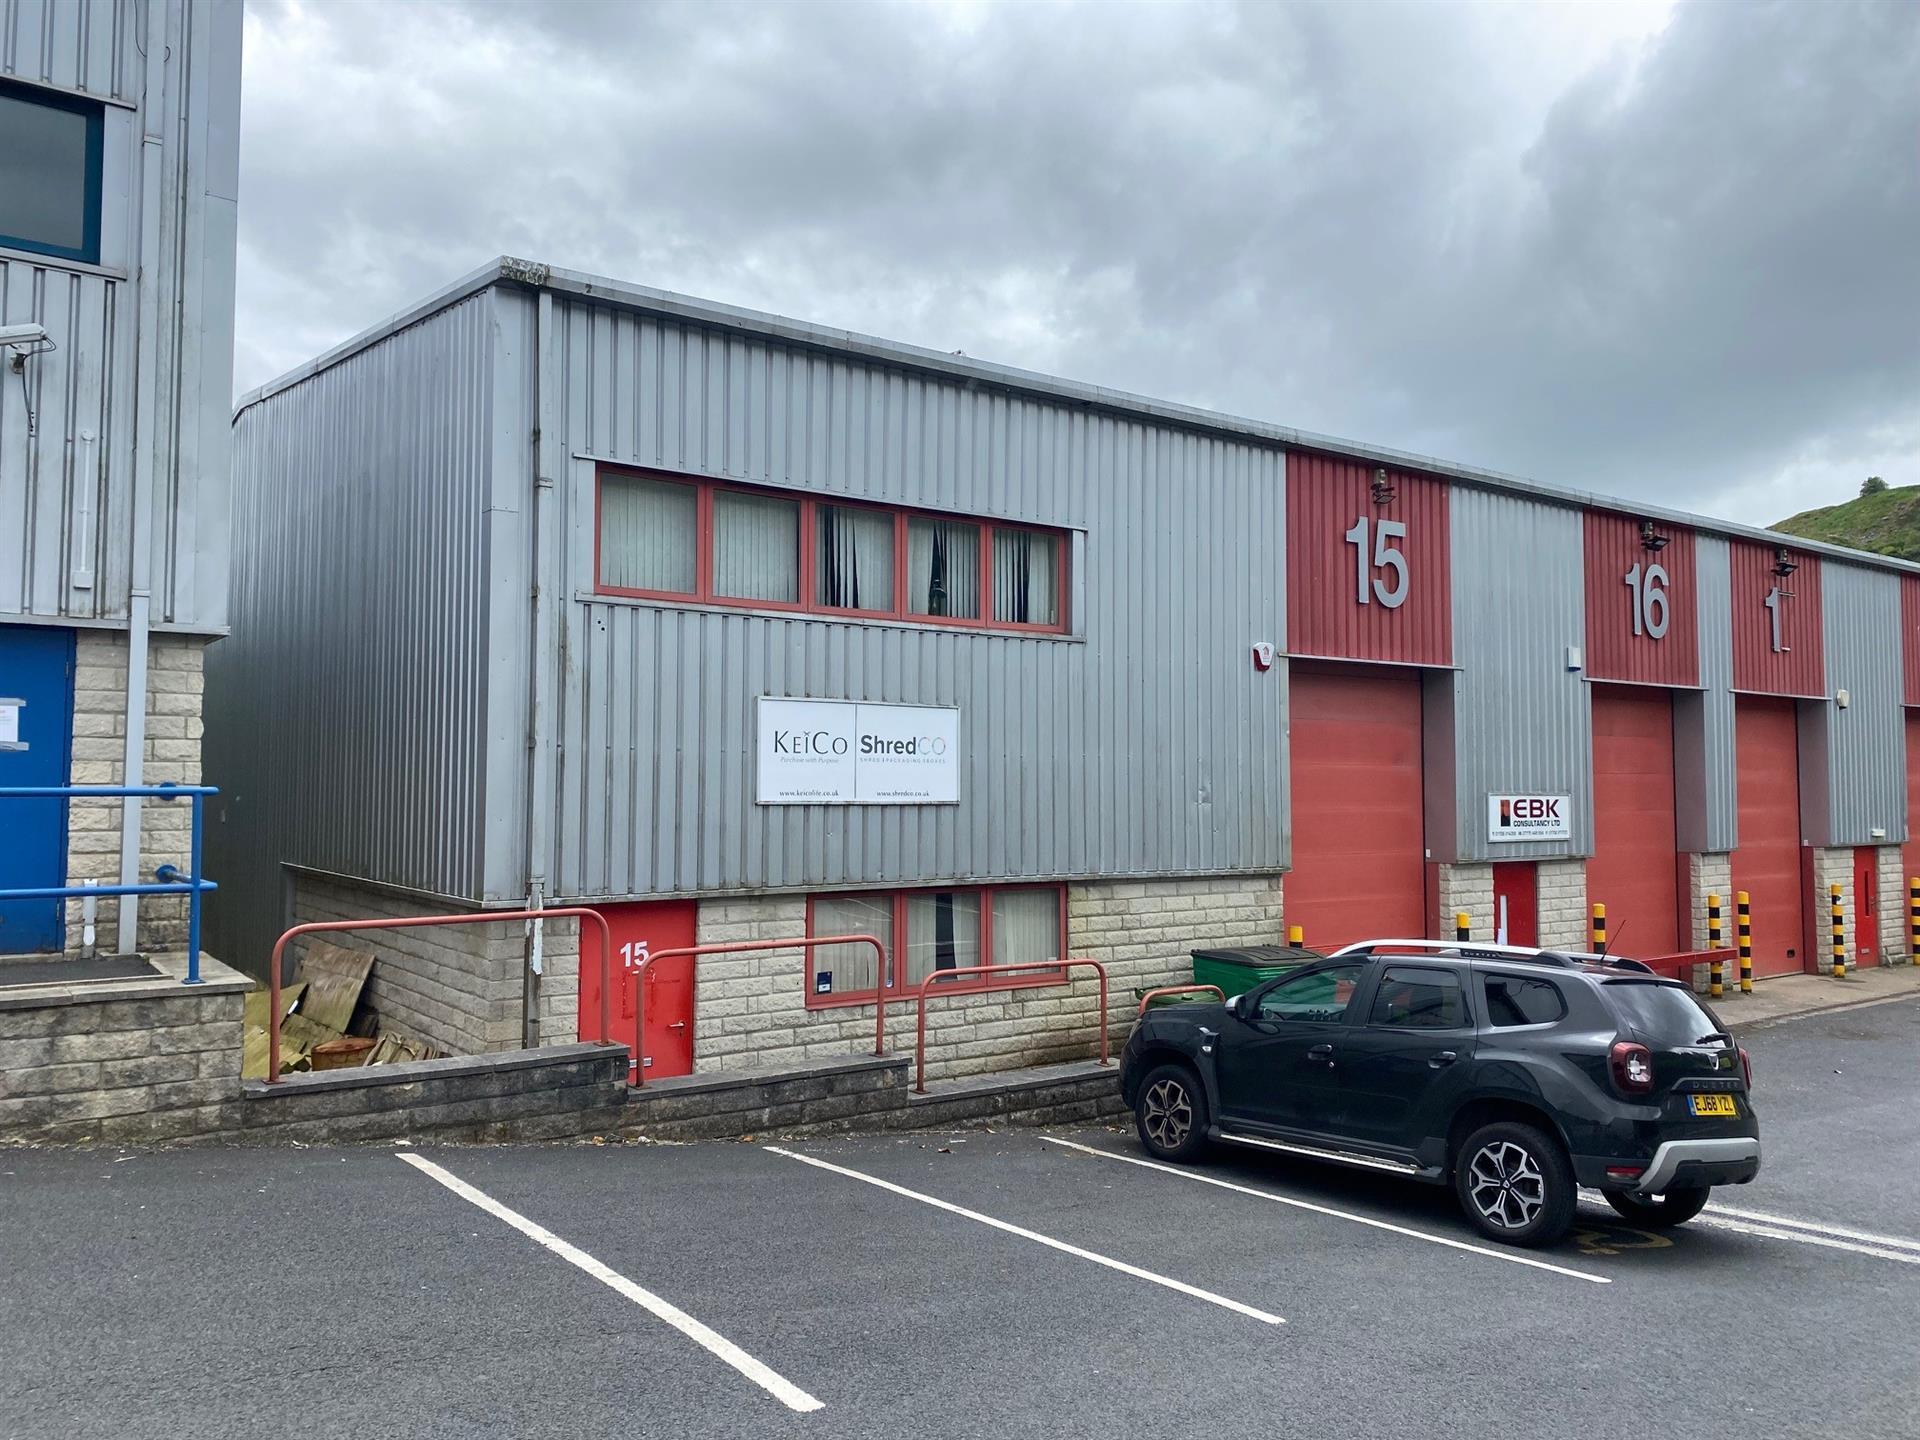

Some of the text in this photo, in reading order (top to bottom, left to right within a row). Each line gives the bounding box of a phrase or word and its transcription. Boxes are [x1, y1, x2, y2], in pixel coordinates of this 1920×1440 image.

[1346, 516, 1409, 608] 15
[1625, 563, 1670, 639] 16
[1513, 799, 1560, 818] EBK
[620, 940, 649, 967] 15
[1693, 1096, 1718, 1111] EJ68
